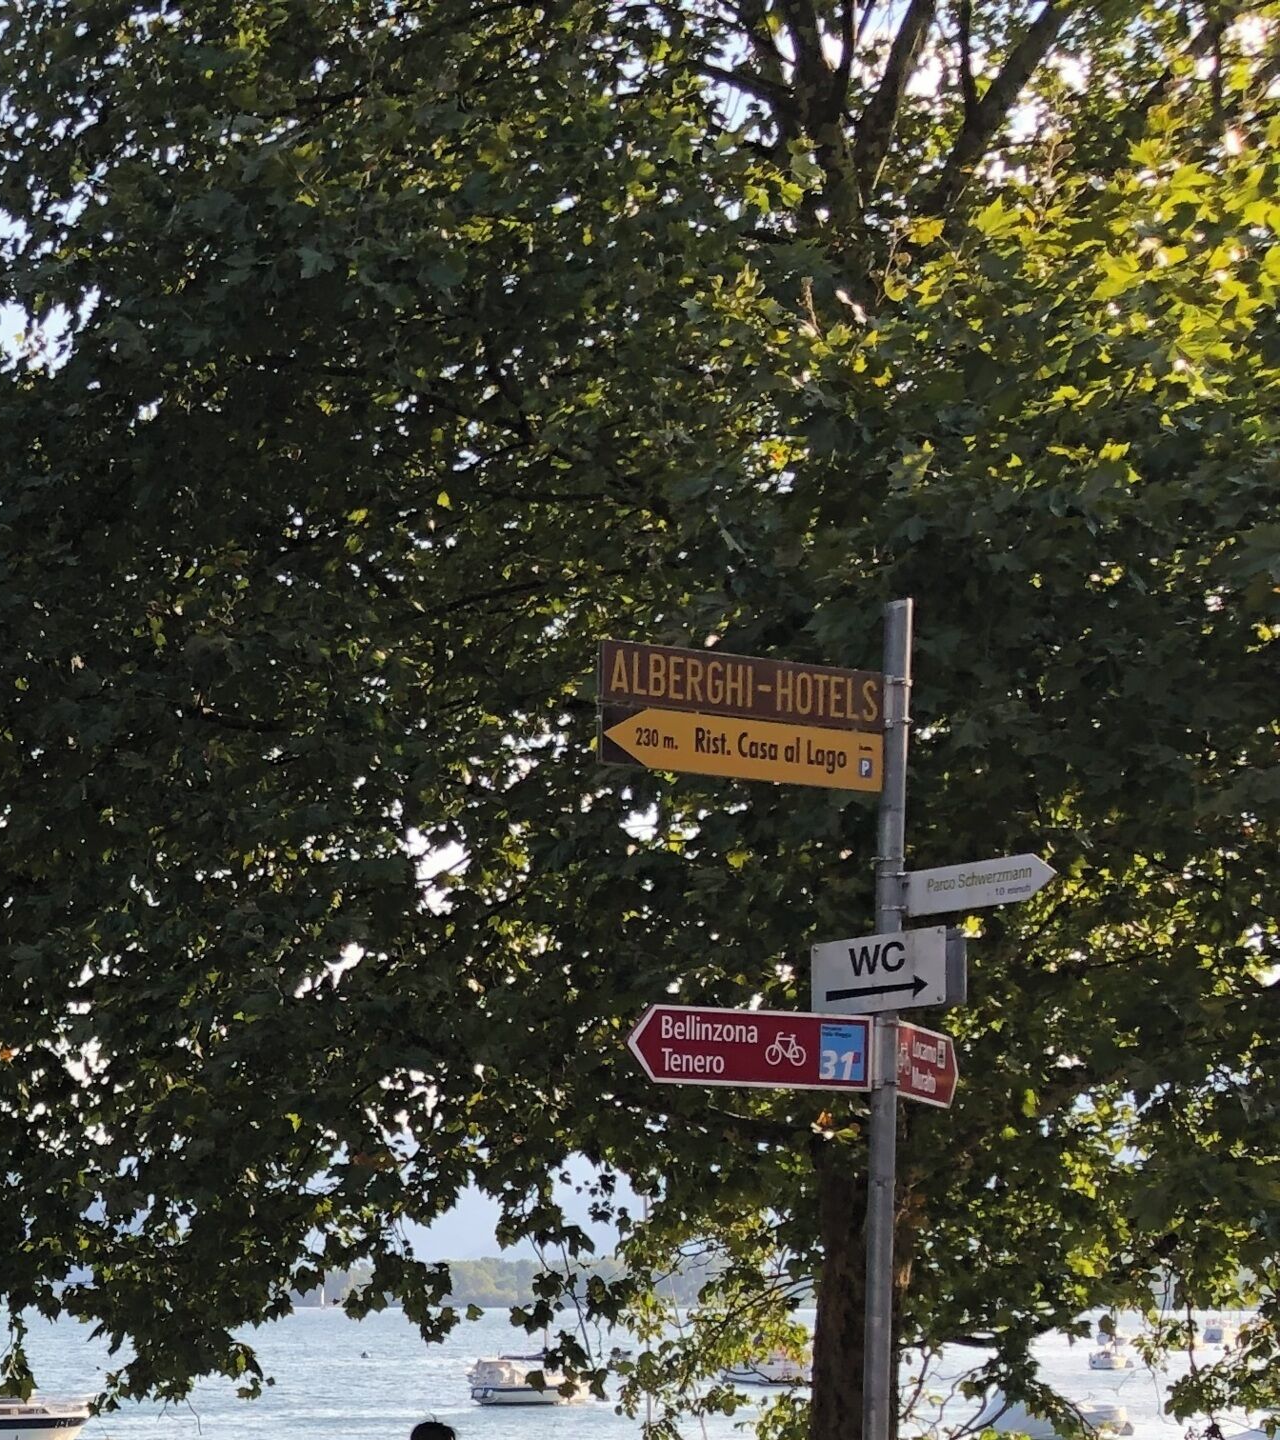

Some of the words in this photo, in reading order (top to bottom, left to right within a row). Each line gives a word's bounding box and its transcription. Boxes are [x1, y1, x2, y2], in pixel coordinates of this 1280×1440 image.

[636, 727, 659, 747] 230
[663, 735, 679, 750] m.
[694, 727, 731, 756] Rist.
[738, 732, 779, 760] Casa
[785, 737, 801, 764] al
[807, 739, 847, 774] Lago
[861, 760, 870, 776] P
[927, 877, 956, 893] Parco
[958, 866, 1032, 889] Schwerzmann
[848, 941, 906, 977] WC
[661, 1014, 758, 1044] Bellinzona
[661, 1048, 725, 1074] Tenero
[819, 1050, 855, 1080] 31
